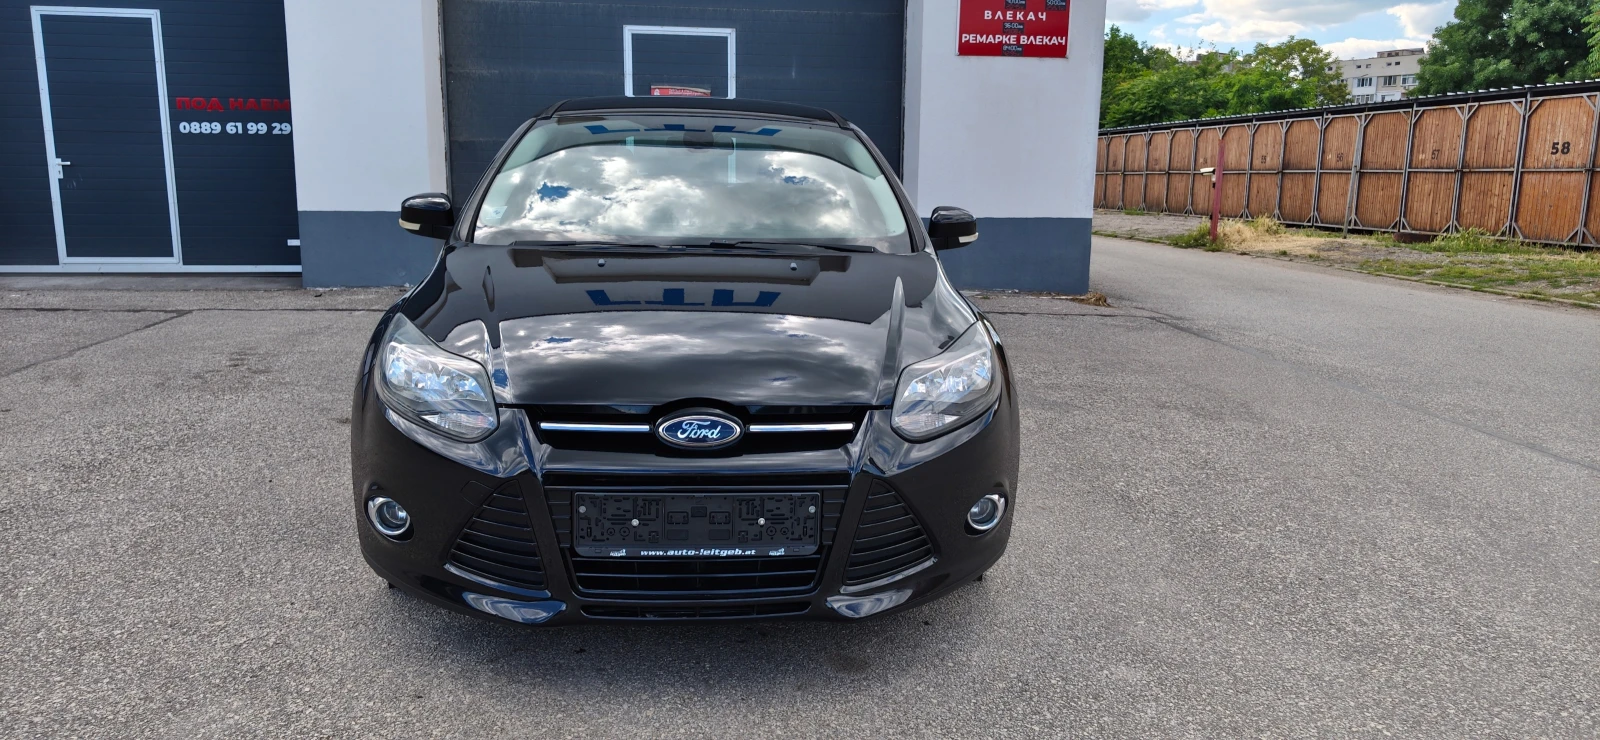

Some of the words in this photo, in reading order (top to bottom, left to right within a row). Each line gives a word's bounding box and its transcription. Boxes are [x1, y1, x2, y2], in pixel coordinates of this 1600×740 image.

[984, 10, 1047, 21] ВЛЕКАЧ
[961, 33, 1017, 45] РЕМАРКЕ
[1019, 35, 1066, 46] ВЛЕКАЧ
[175, 97, 224, 112] ПОД
[228, 97, 291, 112] НАЕМ
[179, 121, 222, 134] 0889
[225, 122, 243, 134] 61
[246, 122, 268, 135] 99
[271, 122, 292, 135] 29
[1431, 149, 1440, 160] 57
[1550, 141, 1571, 155] 58
[677, 420, 722, 439] Ford
[640, 548, 756, 557] www.auto-leitgeb.at
